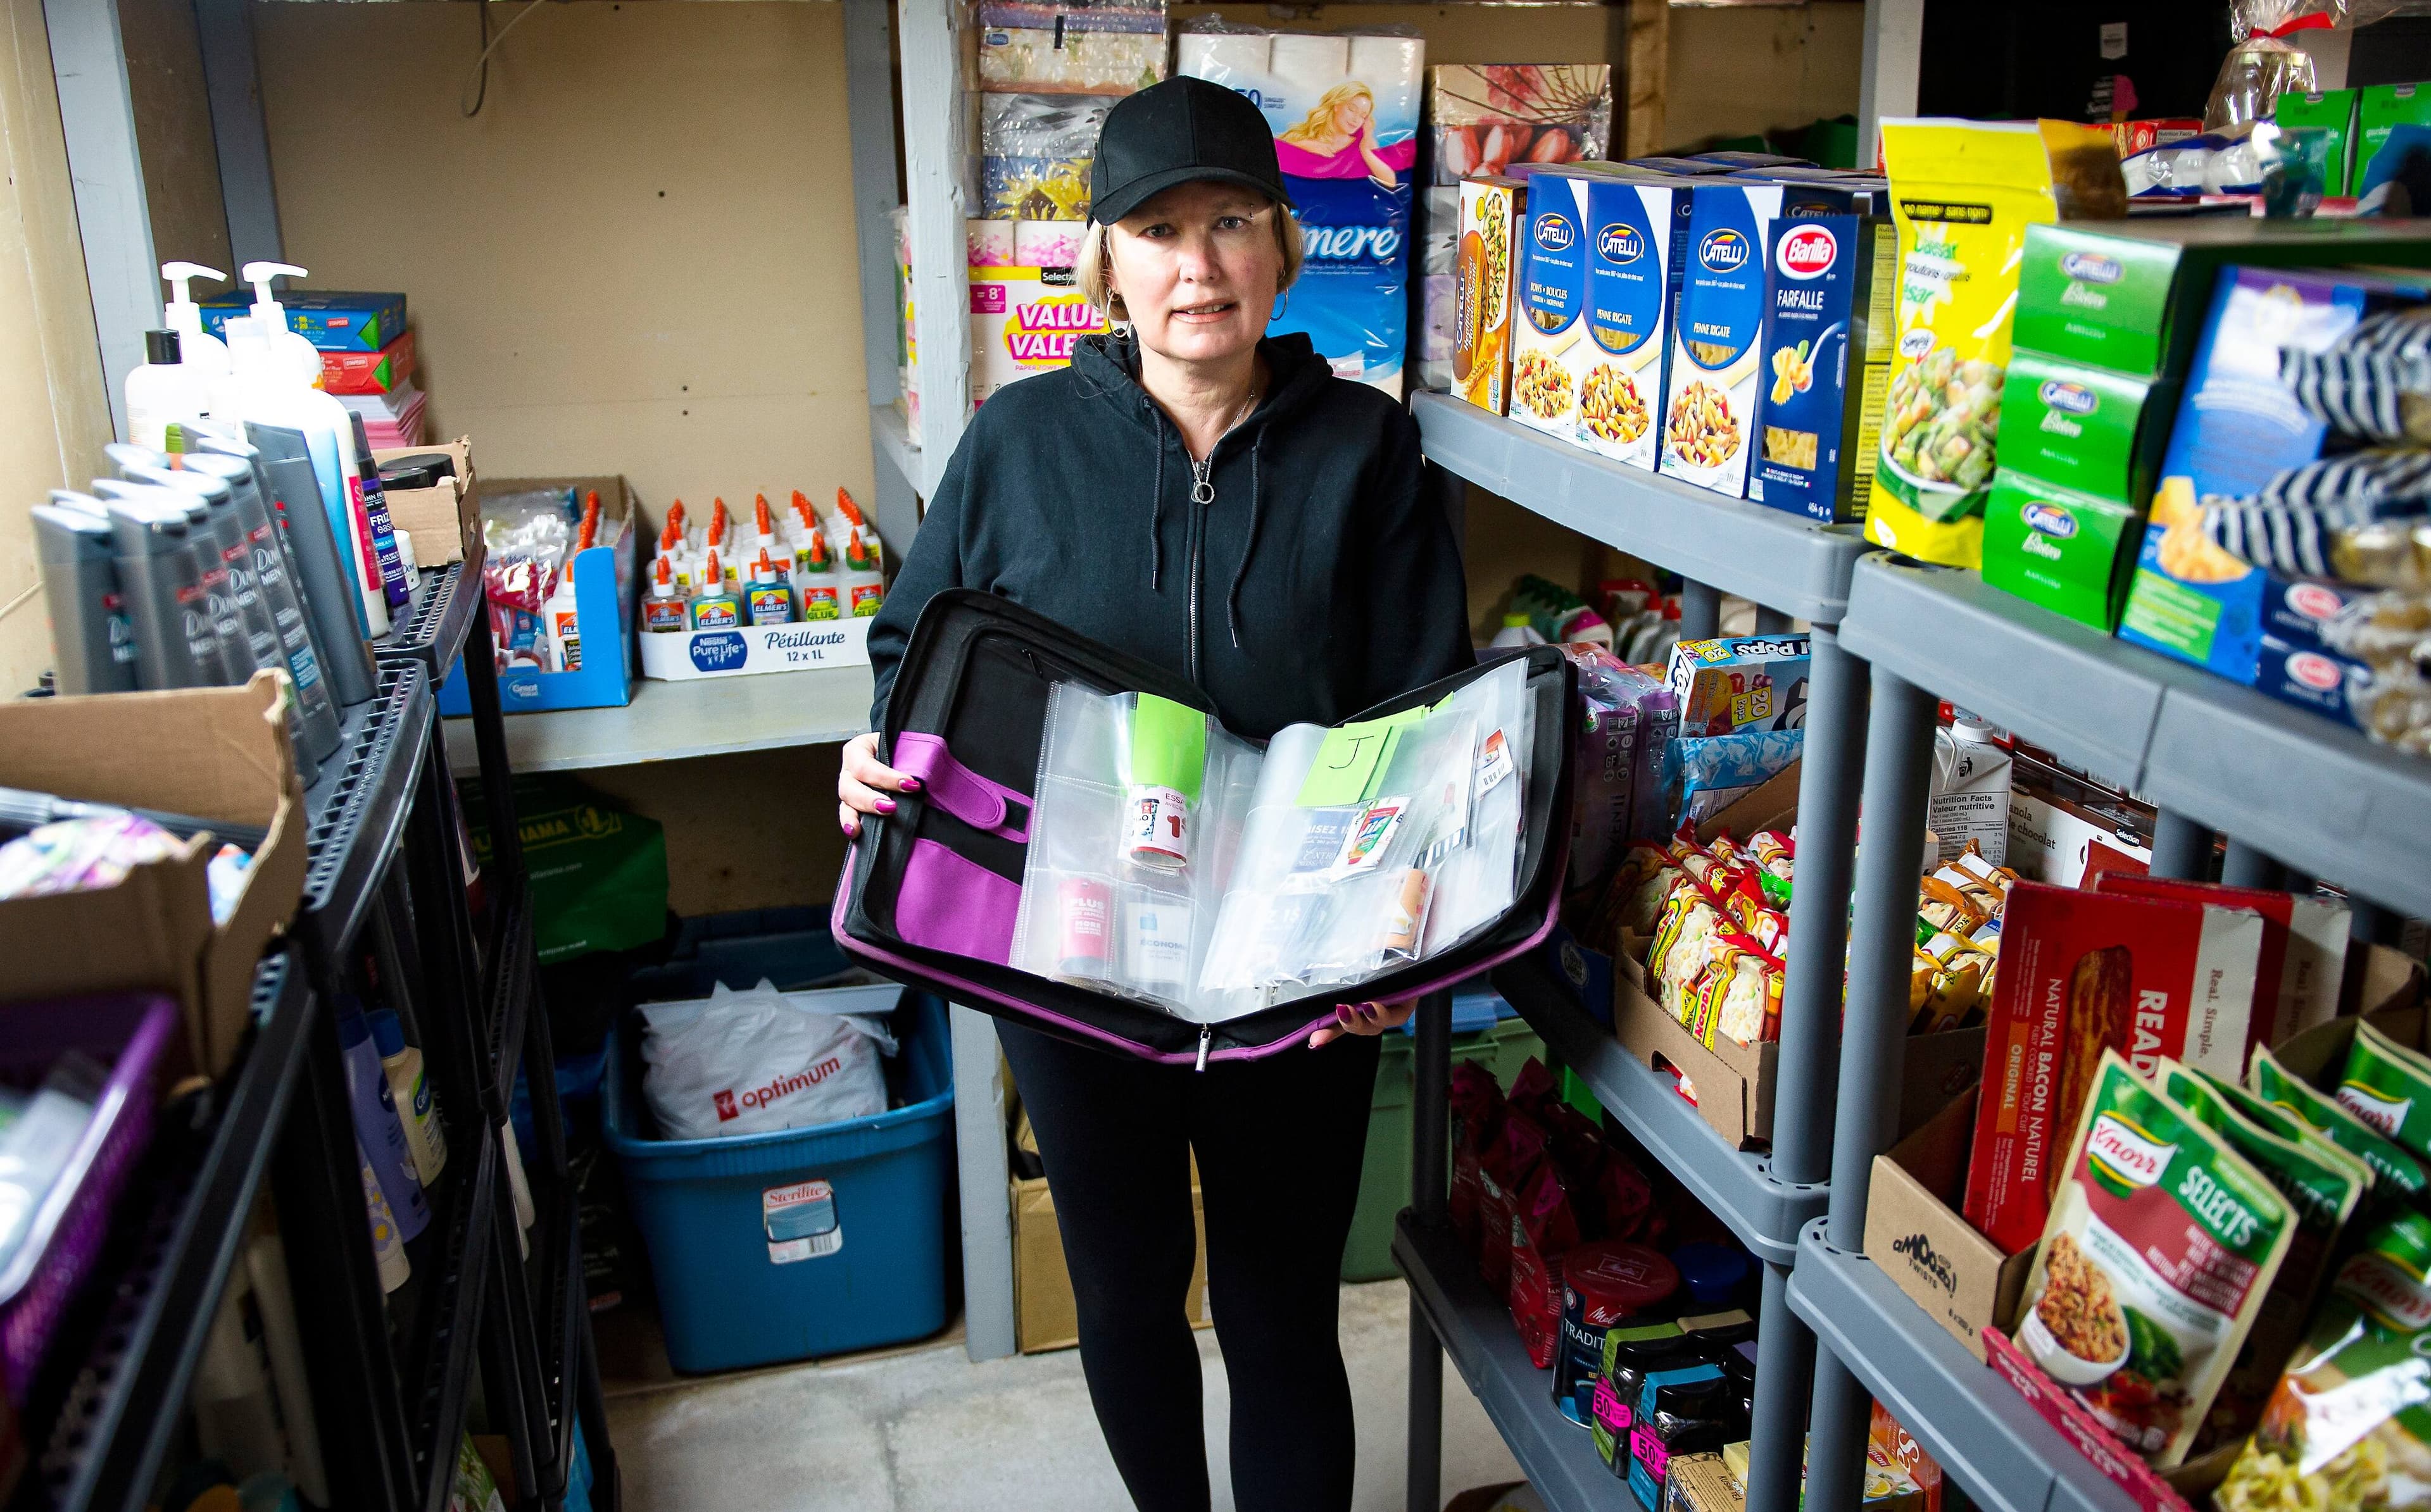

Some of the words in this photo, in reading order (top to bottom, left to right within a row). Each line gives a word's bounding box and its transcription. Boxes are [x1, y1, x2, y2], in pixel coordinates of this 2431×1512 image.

[1904, 204, 1915, 216] no
[1916, 205, 1940, 217] name
[1945, 206, 1966, 218] sans
[1303, 224, 1400, 258] mere
[1538, 221, 1569, 244] CATELLI
[1601, 232, 1637, 256] CATELLI
[1703, 239, 1742, 264] CATELLI
[1787, 237, 1832, 263] Barilla
[1905, 262, 1939, 278] routons
[1546, 285, 1567, 299] BOUCLES
[1777, 290, 1824, 309] FARFALLE
[1017, 304, 1105, 330] VALUE
[1457, 277, 1465, 346] CATELLI
[1597, 308, 1611, 322] PENNE
[1612, 311, 1632, 325] RIGATE
[1693, 322, 1709, 335] PENNE
[1710, 324, 1731, 337] RIGATE
[1008, 334, 1077, 359] VALE
[370, 513, 390, 527] FRIZ
[2024, 505, 2072, 537] CATELLI
[261, 568, 282, 586] MEN
[754, 603, 788, 613] ELMER'S
[807, 611, 838, 621] GLUE
[700, 616, 735, 627] ELMER'S
[693, 645, 719, 657] Pure
[720, 643, 740, 659] Life
[765, 631, 846, 649] Pétillante
[787, 651, 798, 662] 12
[812, 649, 824, 660] 1L
[1704, 647, 1728, 659] 20
[1736, 697, 1749, 720] Pops
[1751, 690, 1769, 718] 20
[1933, 796, 1967, 805] Nutrition
[1933, 804, 1958, 813] Valeur
[1959, 802, 1995, 811] nutritive
[2009, 803, 2033, 822] anola
[2018, 823, 2056, 849] chocolat
[2116, 828, 2140, 846] Selection
[2208, 968, 2223, 1003] Real.
[2039, 978, 2063, 1047] NATURAL
[2032, 1025, 2040, 1046] FULLY
[2131, 989, 2168, 1080] READ
[2199, 1007, 2217, 1058] Simple.
[2004, 1044, 2023, 1109] ORIGINAL
[2026, 1048, 2038, 1085] COOKED
[742, 1057, 841, 1108] optimum
[2032, 1052, 2052, 1113] BACON
[2022, 1092, 2030, 1114] TOUT
[2018, 1114, 2027, 1132] CUIT
[2020, 1117, 2042, 1182] NATUREL
[2094, 1122, 2158, 1175] Knorr
[770, 1185, 822, 1203] Sterilite
[2178, 1165, 2259, 1246] SELECTS
[1565, 1318, 1606, 1351] TRADIT
[1868, 1446, 1888, 1468] ipton
[1731, 1489, 1743, 1502] TEA
